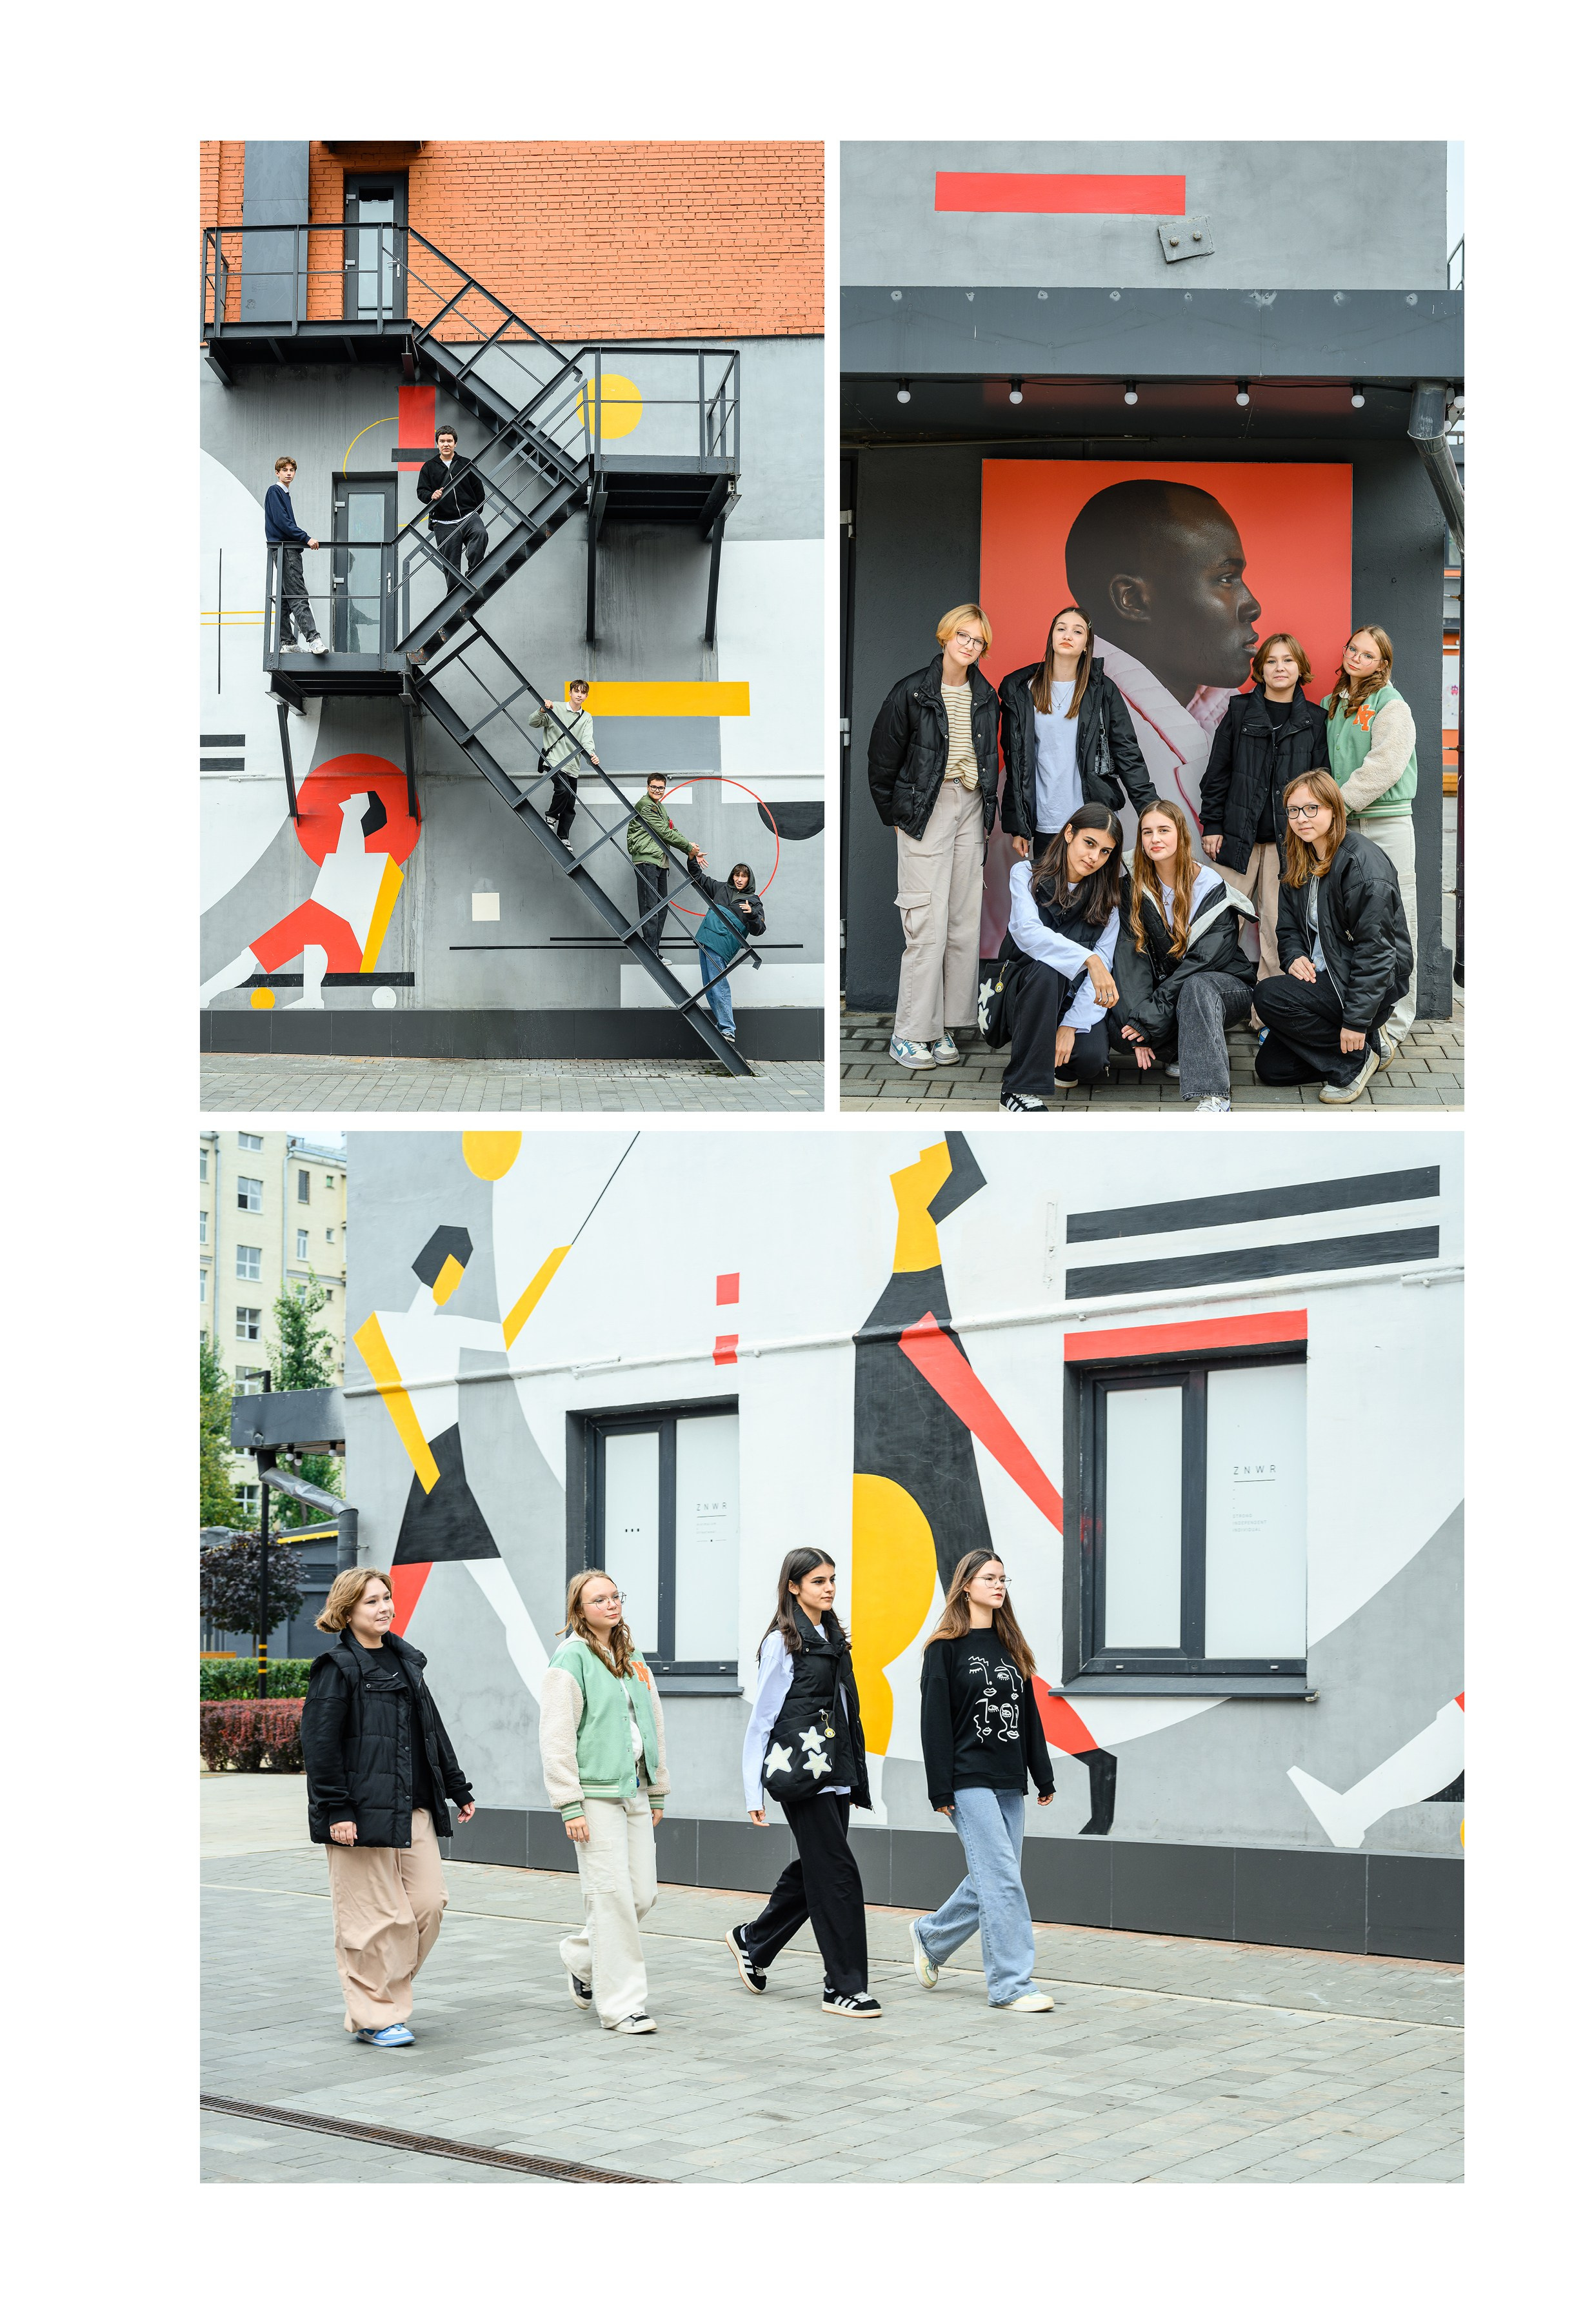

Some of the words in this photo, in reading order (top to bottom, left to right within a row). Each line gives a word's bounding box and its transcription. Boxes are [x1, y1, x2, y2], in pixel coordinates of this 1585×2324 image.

[1352, 704, 1375, 732] NY
[1233, 1465, 1276, 1475] ZNWR
[696, 1502, 727, 1511] ZNWR
